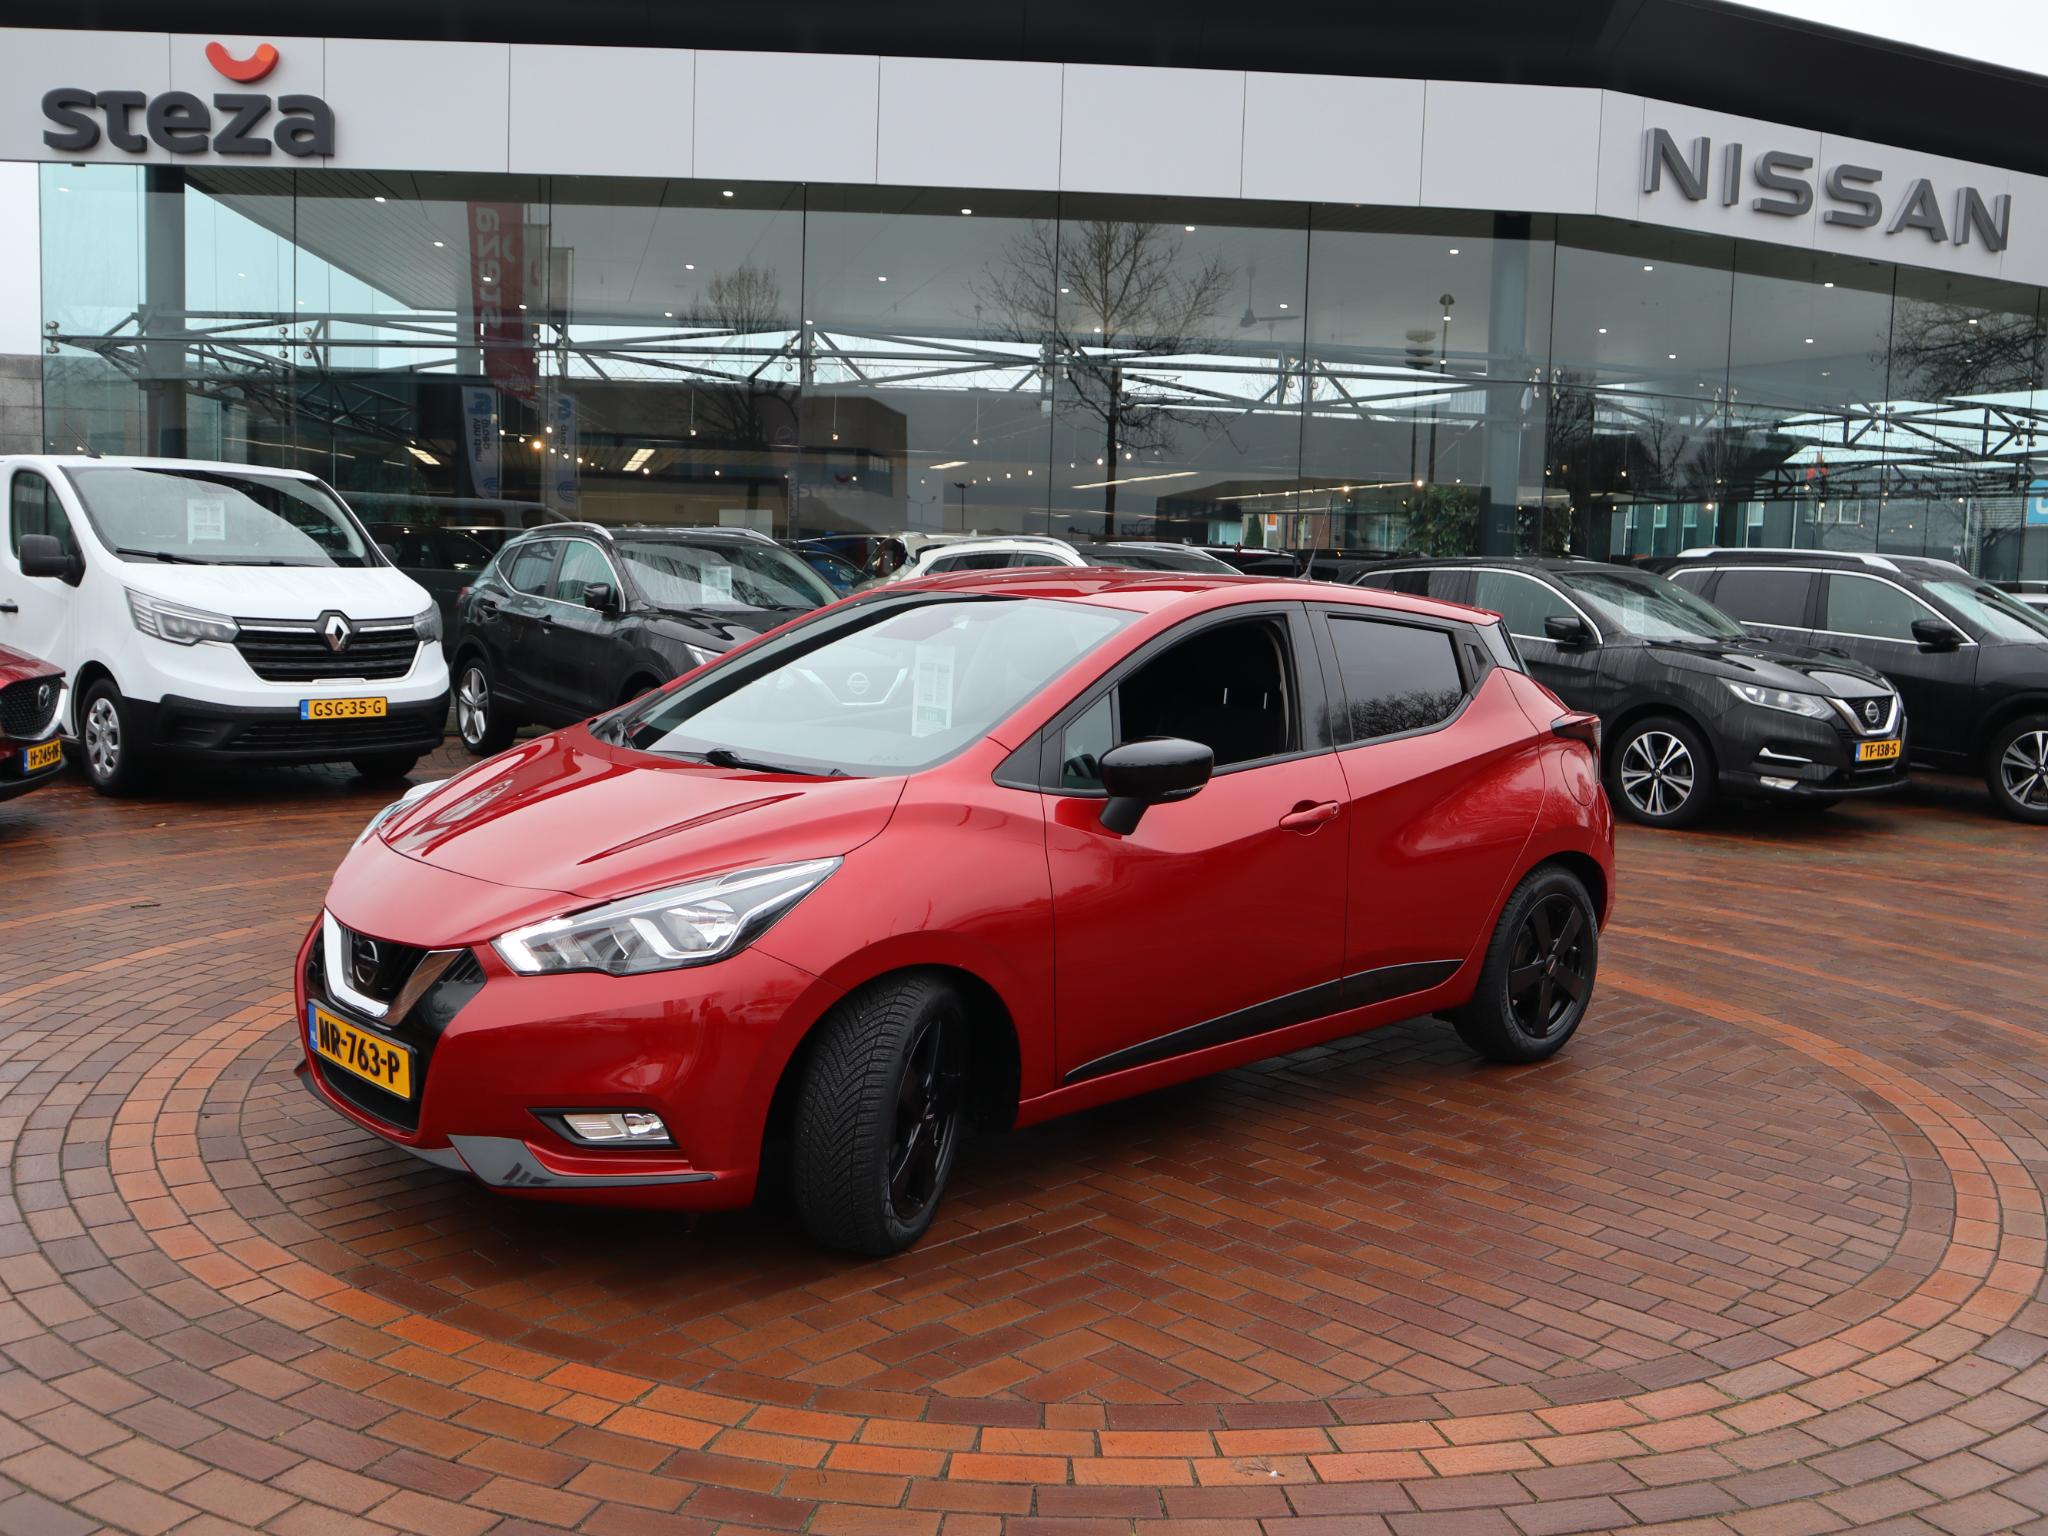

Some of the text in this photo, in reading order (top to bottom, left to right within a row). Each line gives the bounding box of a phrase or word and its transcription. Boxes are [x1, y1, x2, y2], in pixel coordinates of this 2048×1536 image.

[42, 87, 335, 157] steza
[1643, 127, 2011, 252] NISSAN
[313, 700, 382, 716] GSG-35-G
[1865, 743, 1896, 757] TF-138-S
[318, 1017, 399, 1083] NR-763-P
